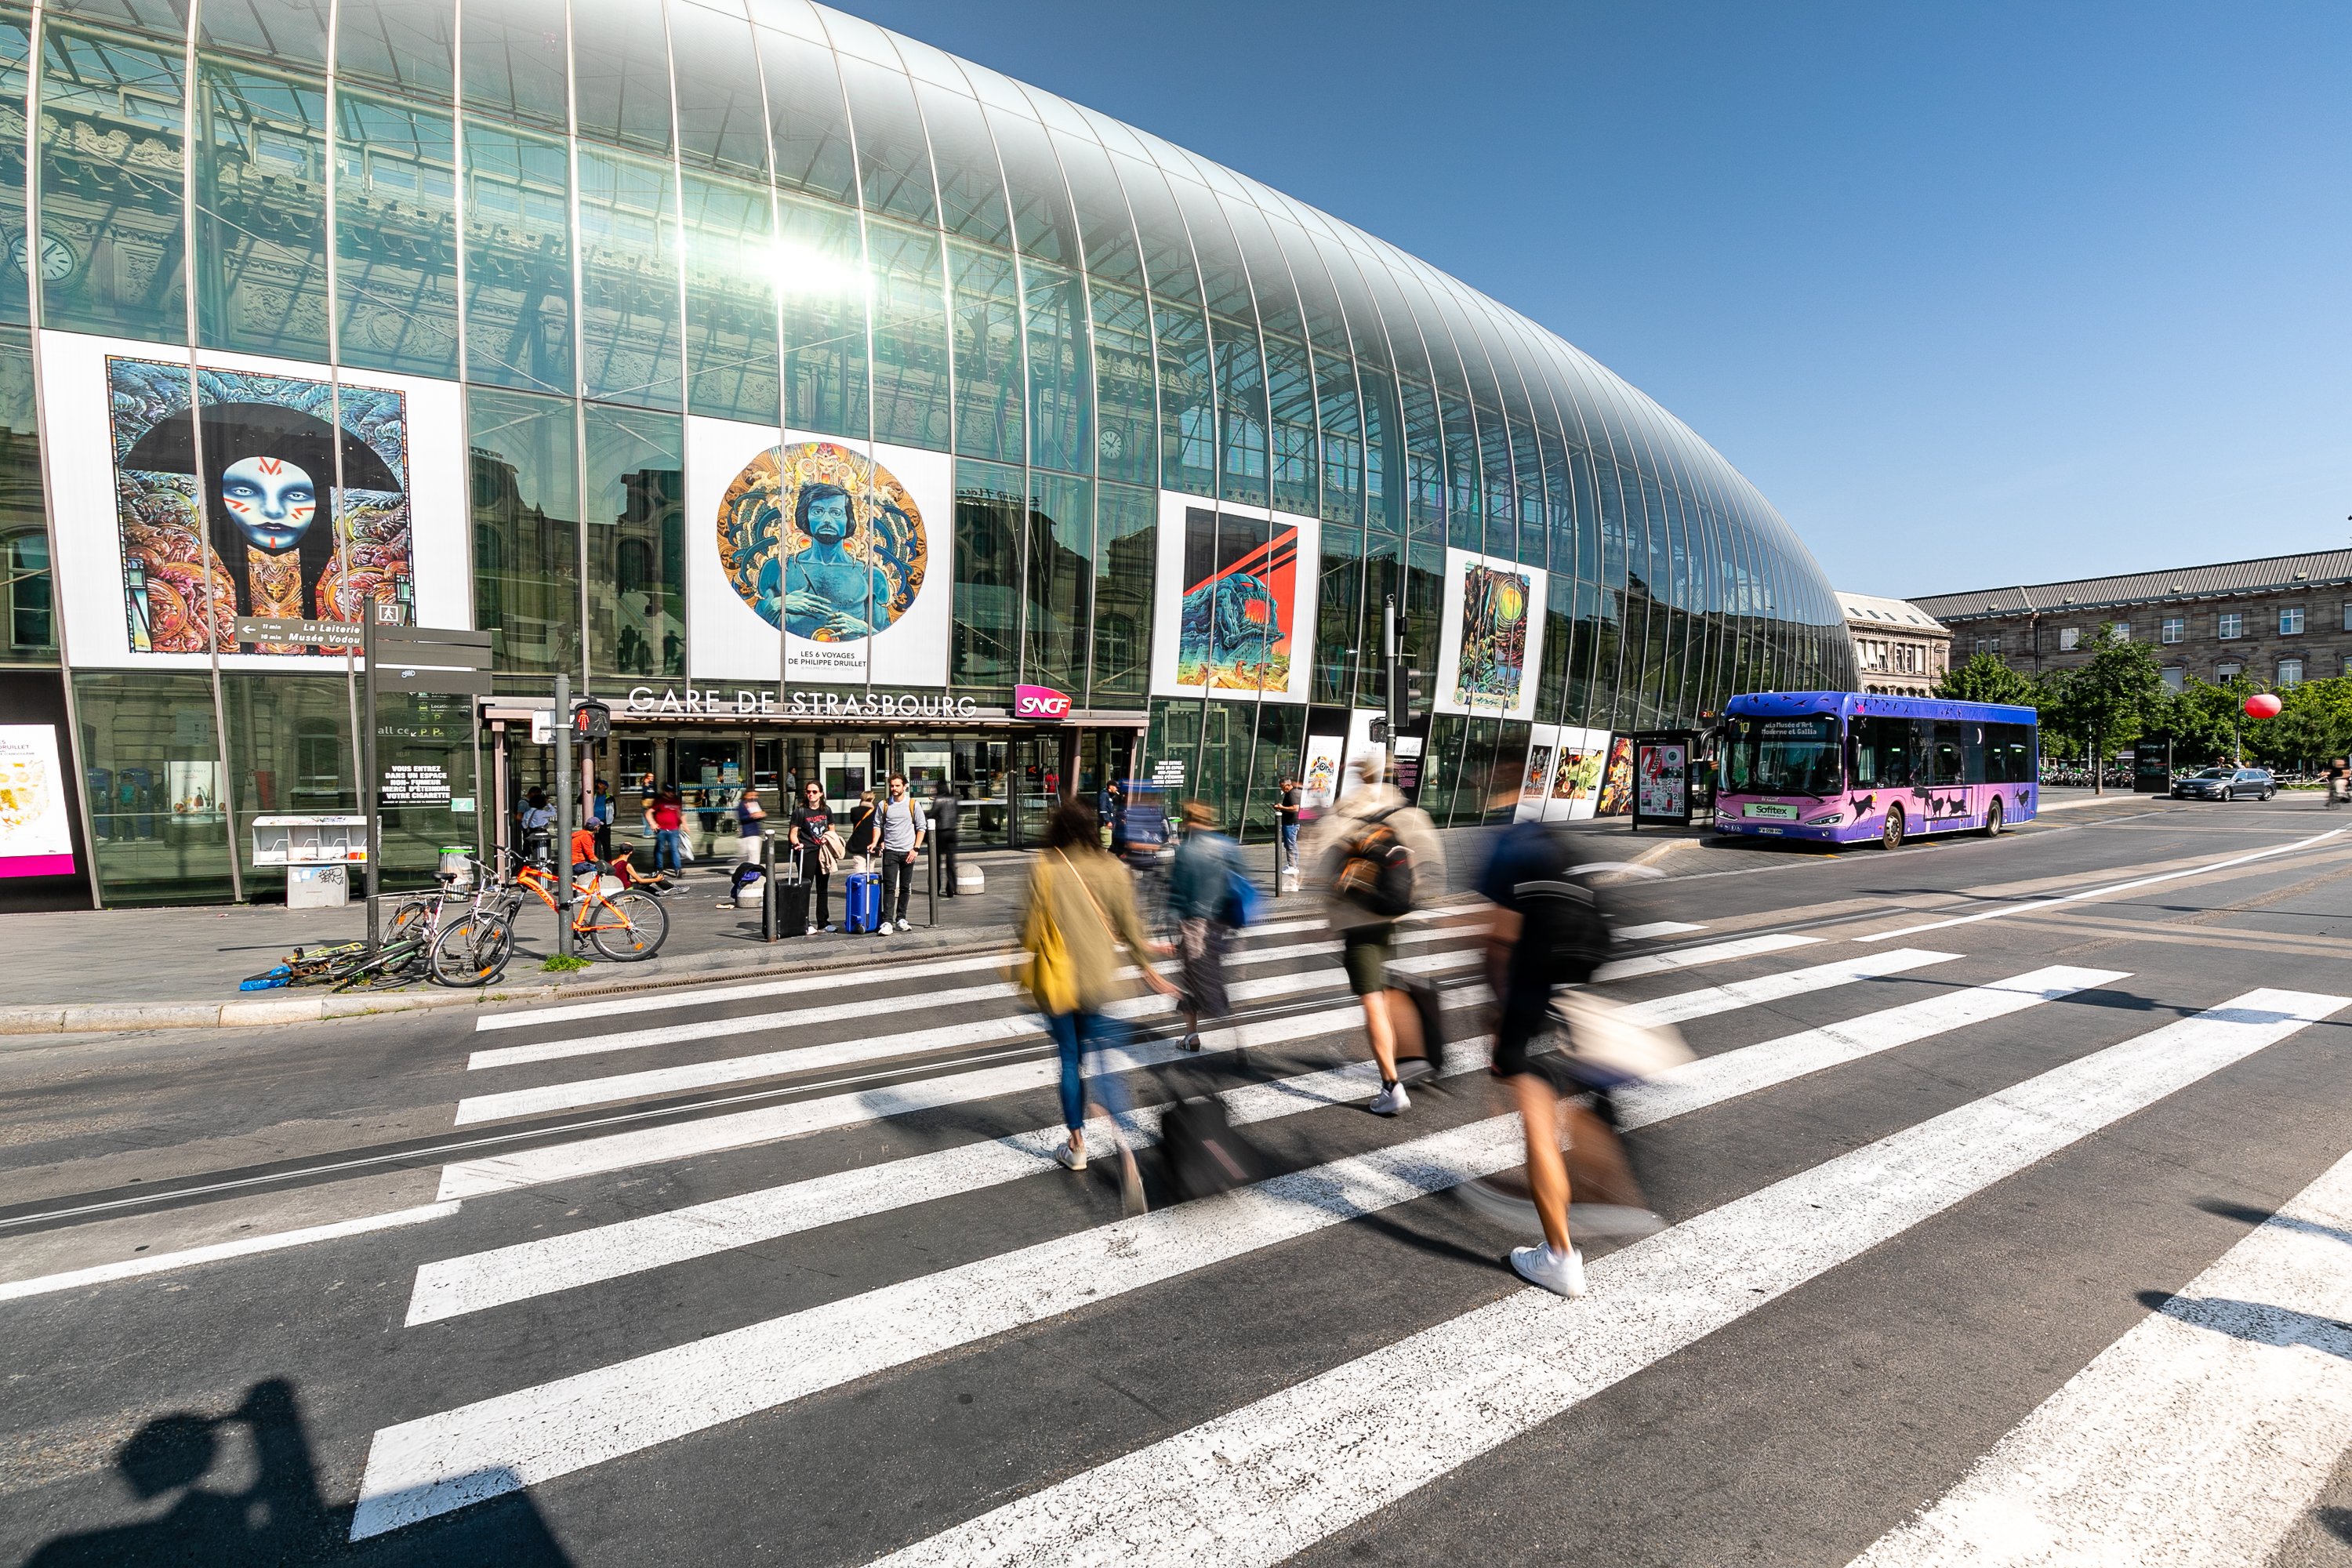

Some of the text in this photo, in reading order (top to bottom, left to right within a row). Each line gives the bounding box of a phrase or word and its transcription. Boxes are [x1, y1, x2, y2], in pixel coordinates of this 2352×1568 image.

[320, 624, 360, 633] Laiterie
[289, 633, 360, 644] Musée Vodou
[629, 686, 978, 718] GARE DE STRASBOURG
[1019, 697, 1069, 713] SNCF
[378, 726, 394, 735] all
[1739, 722, 1749, 733] 10
[1755, 805, 1787, 815] Sofitex
